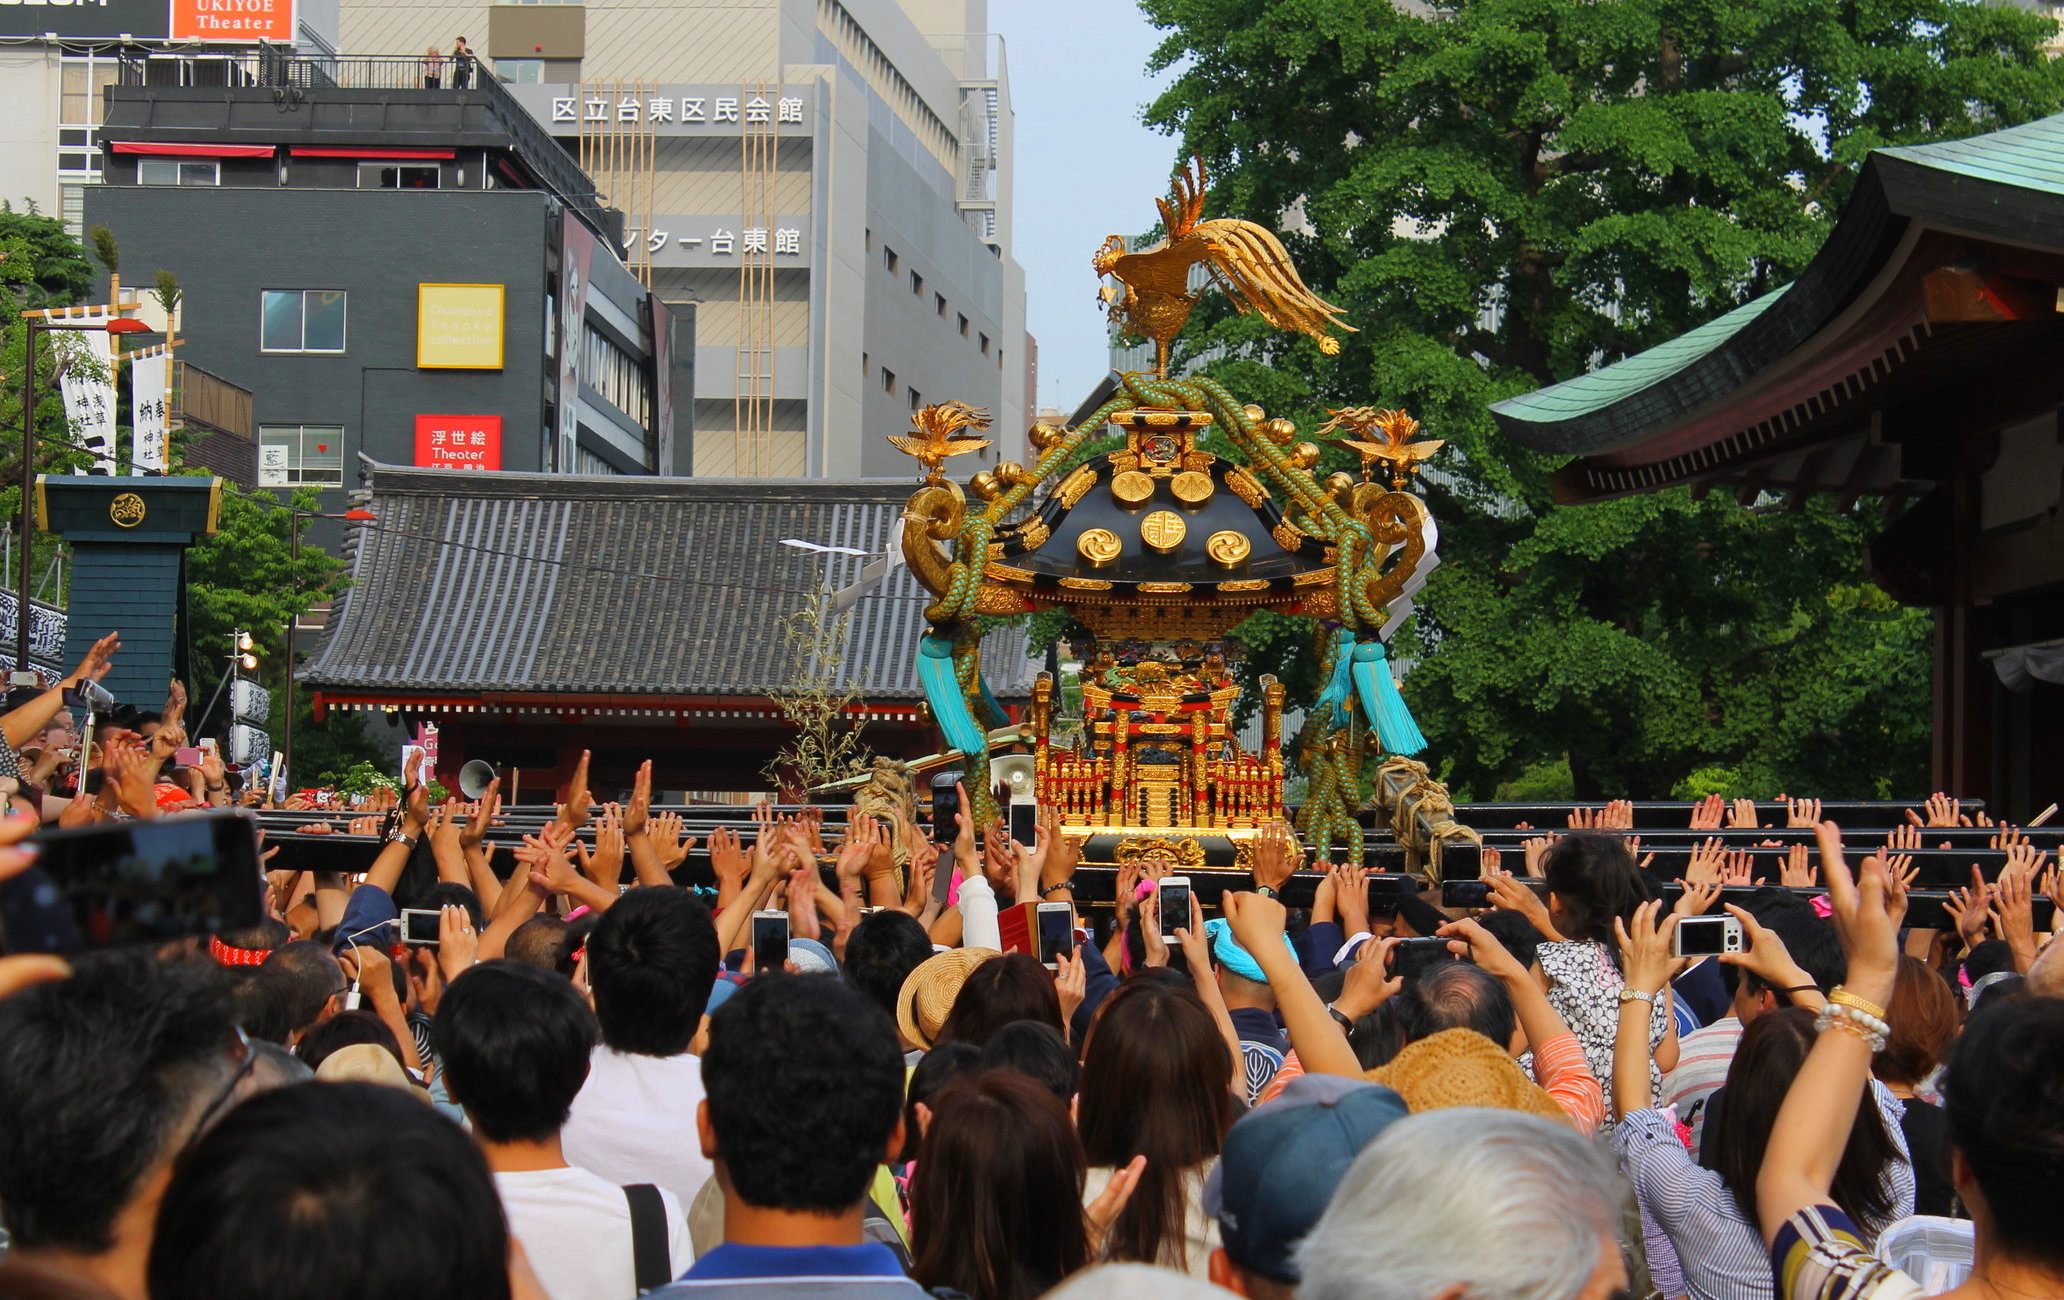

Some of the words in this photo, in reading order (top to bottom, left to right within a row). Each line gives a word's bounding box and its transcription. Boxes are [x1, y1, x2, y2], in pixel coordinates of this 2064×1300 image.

[197, 0, 274, 12] UKIYOE
[196, 14, 273, 29] Theater
[552, 96, 803, 123] 区立台東区民会館
[431, 430, 486, 446] 浮世絵
[431, 447, 485, 460] Theater
